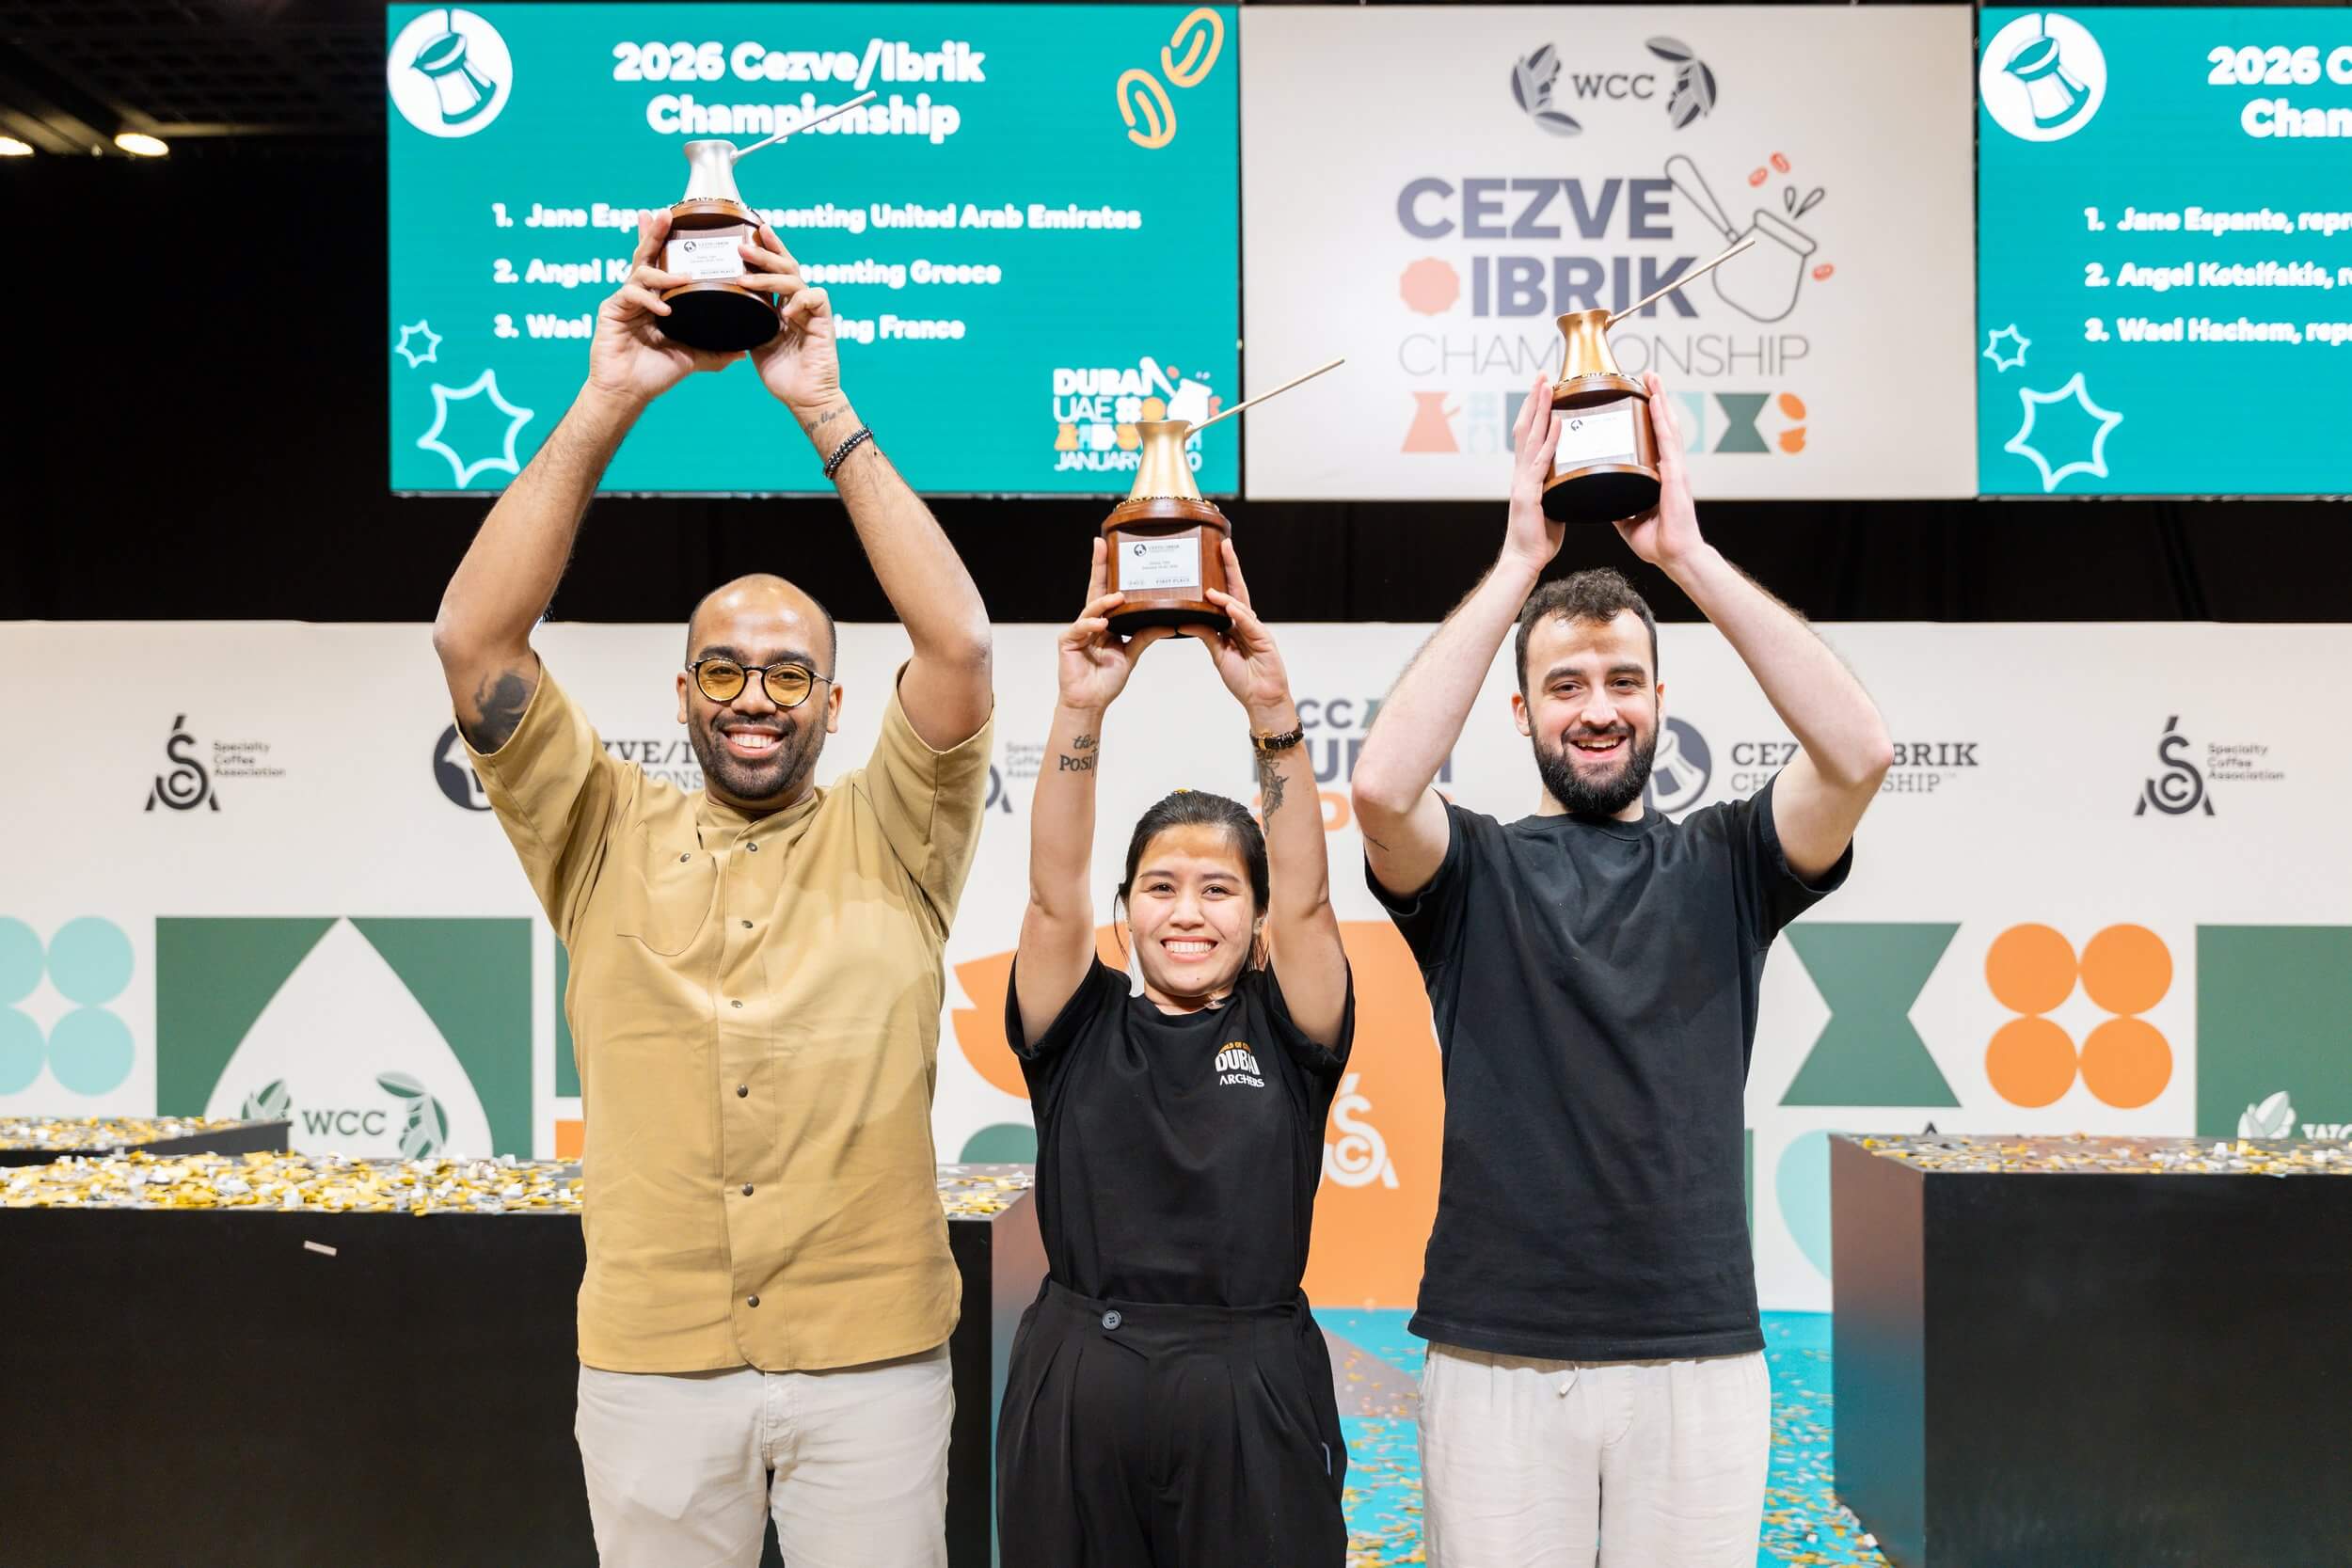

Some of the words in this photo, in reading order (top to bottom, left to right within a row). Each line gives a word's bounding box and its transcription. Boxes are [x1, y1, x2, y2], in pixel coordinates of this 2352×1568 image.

[612, 41, 726, 81] 2026
[730, 38, 986, 91] Cezve/Ibrik
[2207, 45, 2322, 85] 2026
[1572, 73, 1654, 99] WCC
[646, 92, 961, 144] Championship
[492, 202, 514, 228] 1.
[525, 202, 588, 228] Jane
[870, 202, 957, 229] United
[959, 202, 1024, 230] Arab
[1027, 202, 1142, 230] Emirates
[1397, 177, 1674, 241] CEZVE
[2084, 206, 2106, 231] 1.
[2117, 206, 2181, 231] Jane
[493, 258, 519, 283] 2.
[525, 258, 602, 289] Angel
[910, 259, 1002, 284] Greece
[2085, 261, 2110, 287] 2.
[2117, 261, 2194, 292] Angel
[1471, 256, 1699, 319] IBRIK
[493, 313, 519, 339] 3.
[525, 313, 593, 339] Wael
[879, 313, 965, 340] France
[2085, 317, 2110, 341] 3.
[2117, 317, 2184, 341] Wael
[1398, 333, 1809, 376] CHAMONSHIP
[1053, 396, 1114, 423] UAE
[1295, 699, 1353, 729] CC
[214, 755, 256, 765] Coffee
[2208, 743, 2268, 755] Specialty
[2208, 757, 2252, 768] Coffee
[2208, 771, 2285, 780] Association
[1215, 1049, 1261, 1075] DUBAI
[301, 1110, 387, 1136] WCC
